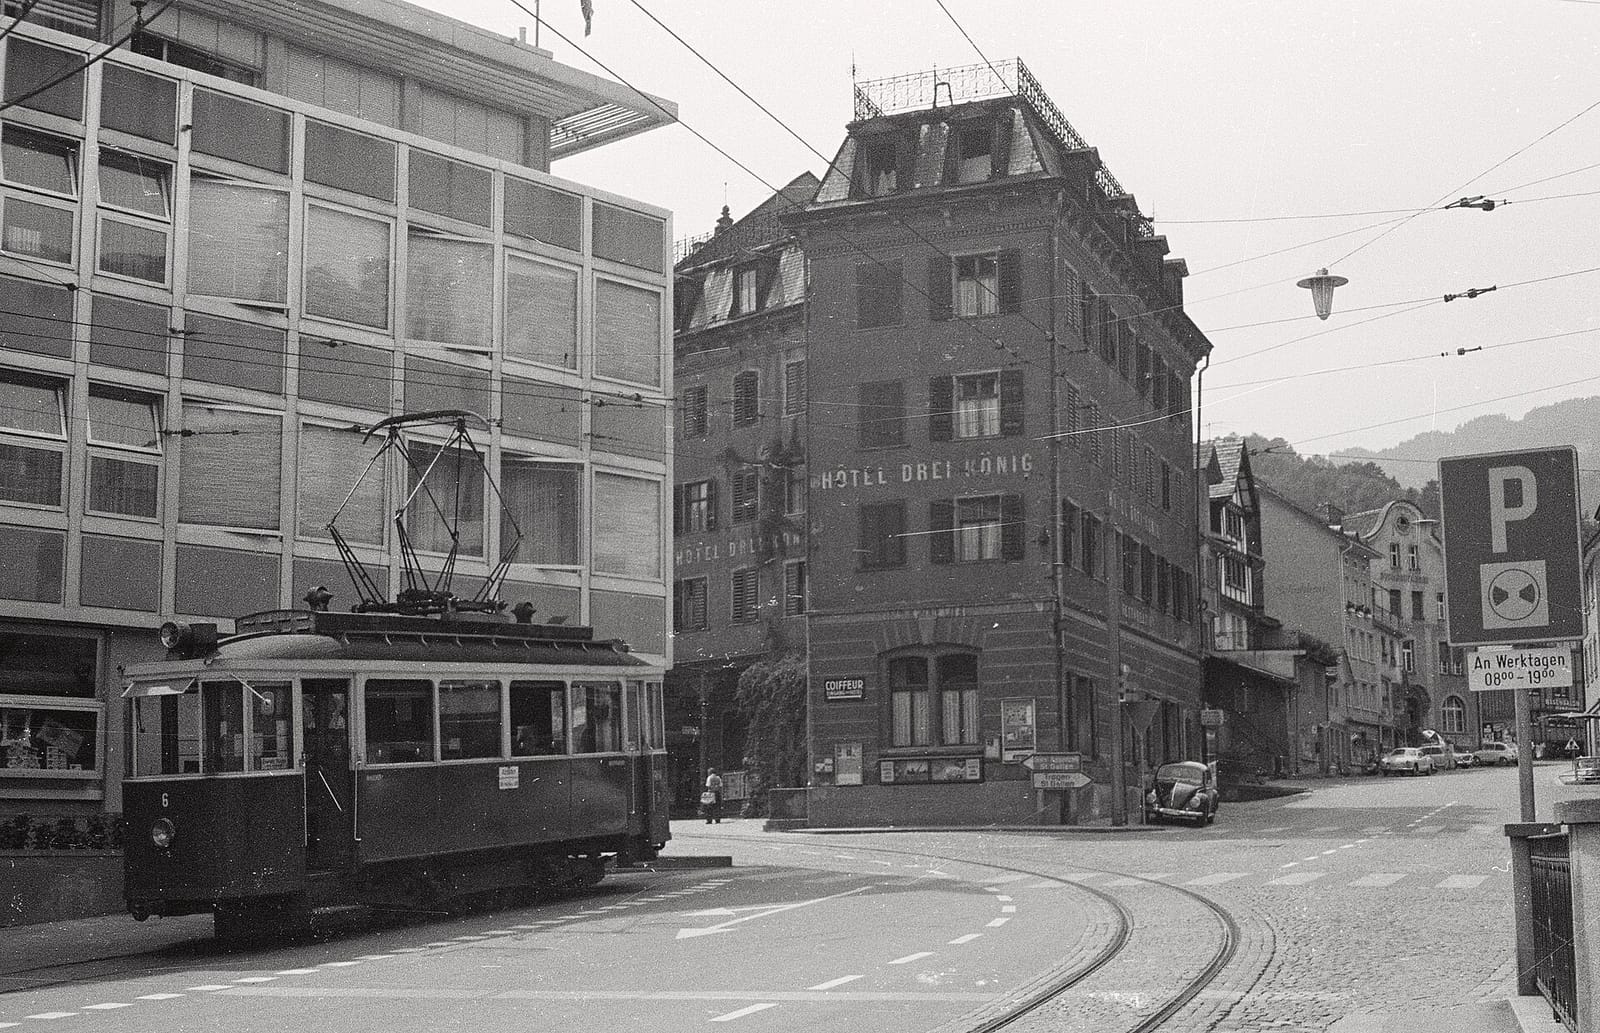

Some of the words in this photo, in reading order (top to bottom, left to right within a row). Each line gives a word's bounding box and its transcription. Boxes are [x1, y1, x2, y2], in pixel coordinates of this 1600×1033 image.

[902, 460, 951, 482] DREI
[1488, 465, 1538, 553] P
[1474, 656, 1491, 670] An
[1496, 653, 1565, 670] Werktagen
[825, 679, 863, 691] COIFFEUR
[161, 792, 169, 807] 6
